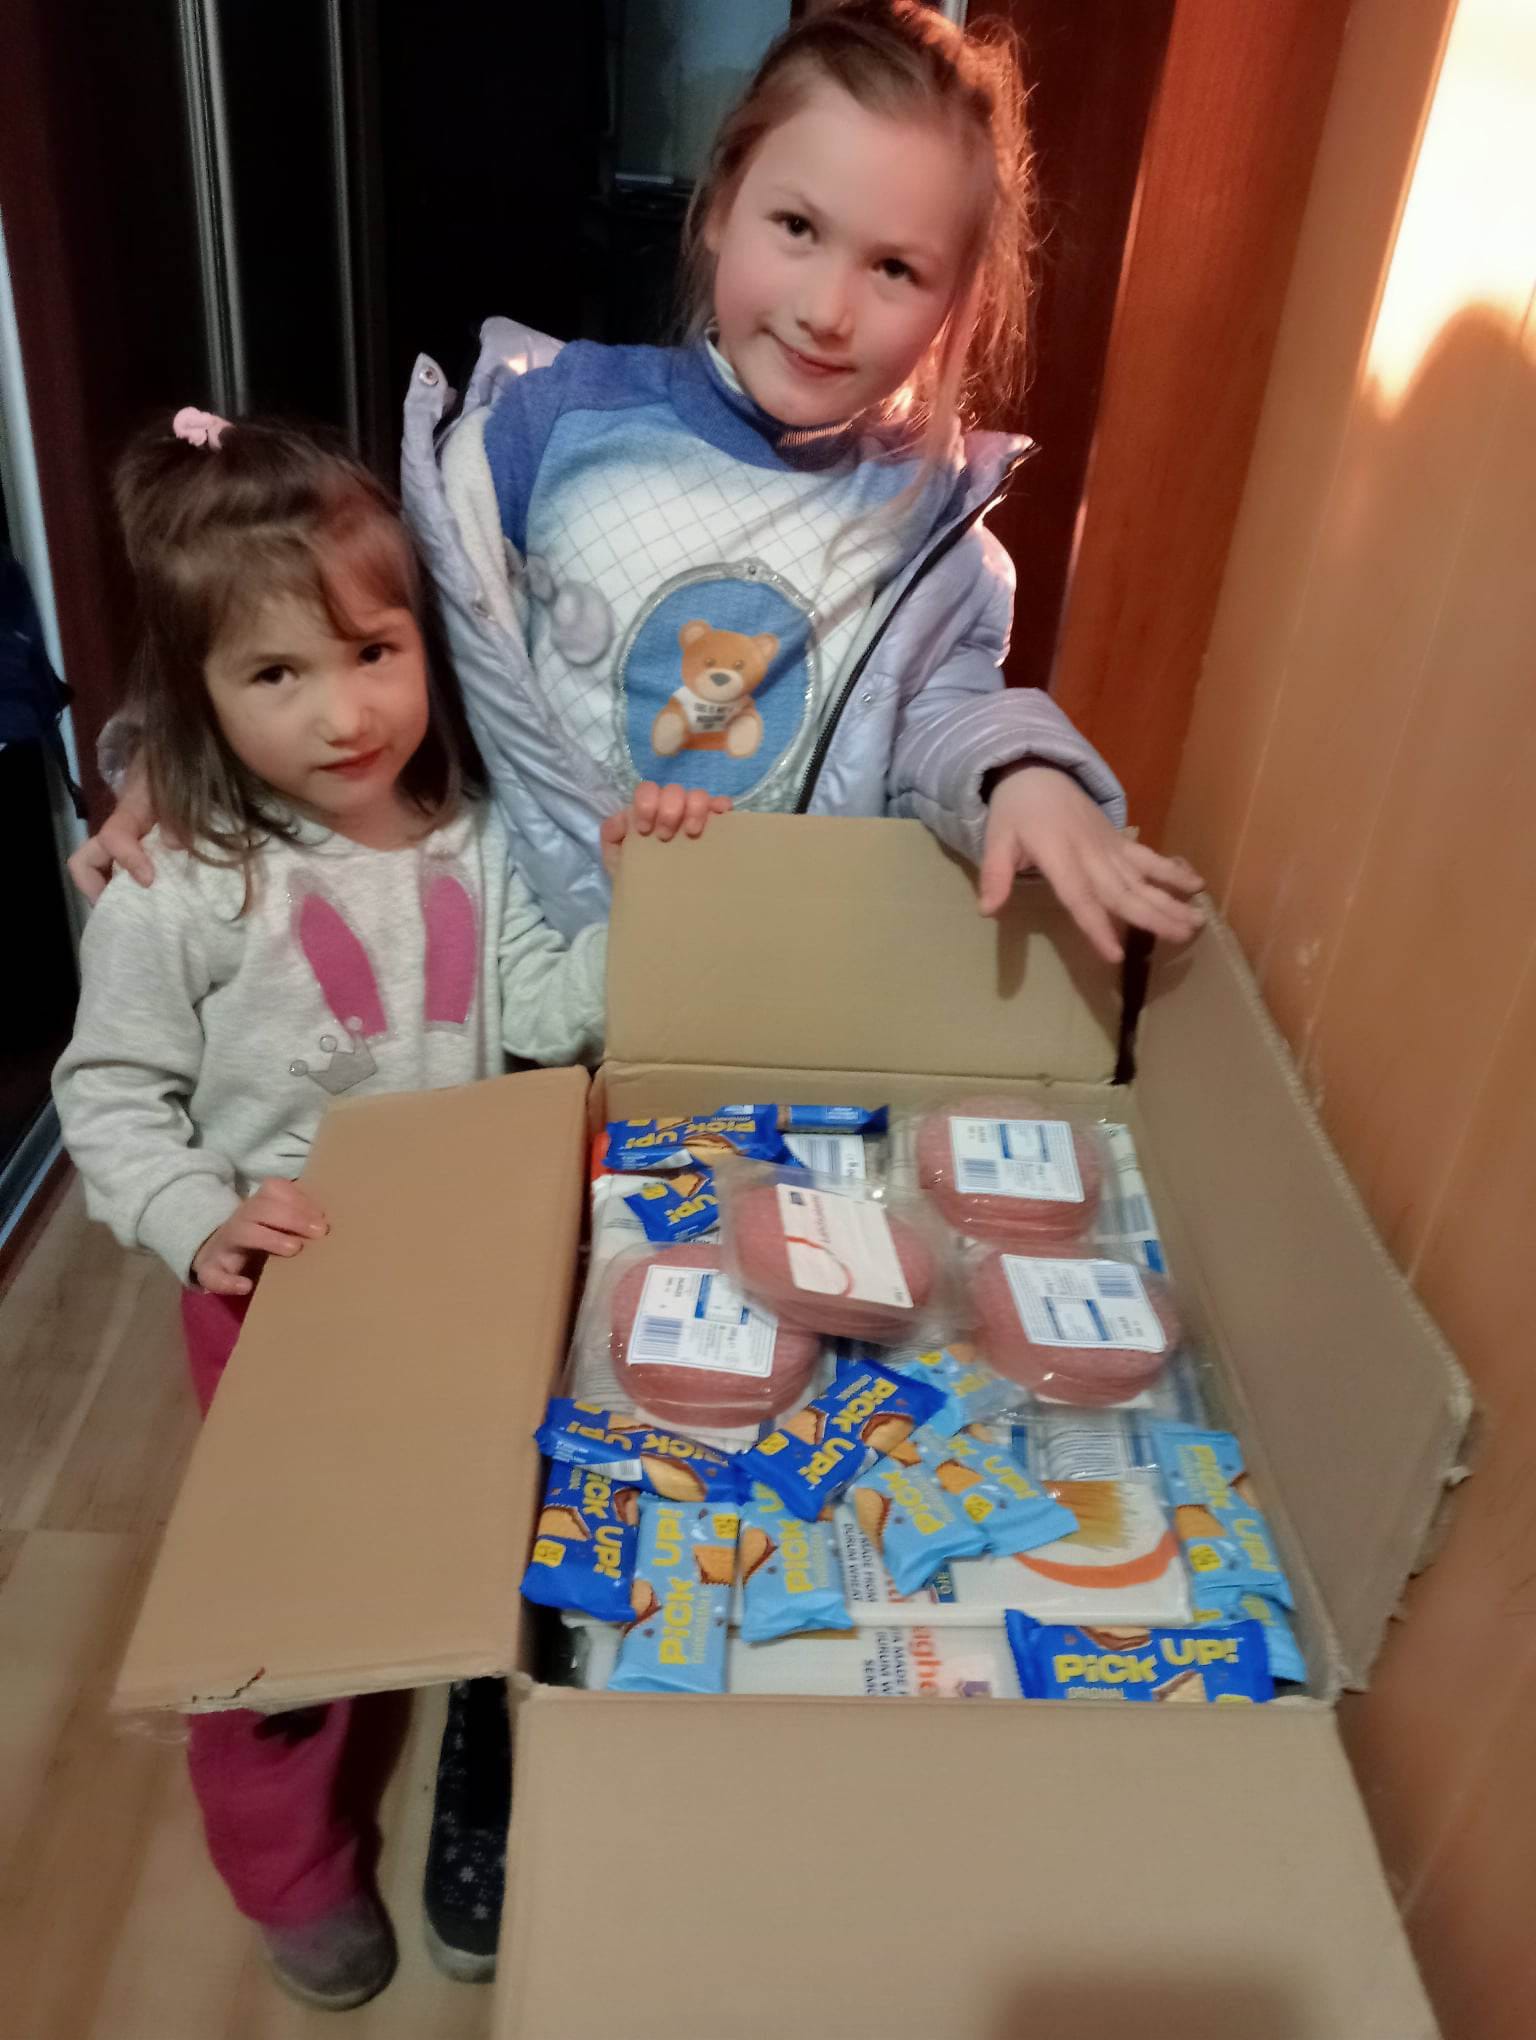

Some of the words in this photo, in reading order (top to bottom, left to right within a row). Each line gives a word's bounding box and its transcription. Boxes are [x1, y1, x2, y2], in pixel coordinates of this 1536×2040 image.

[797, 1437, 857, 1486] UP!
[593, 1525, 625, 1579] UP!
[651, 1508, 686, 1567] UP!
[1160, 1637, 1240, 1666] UP!
